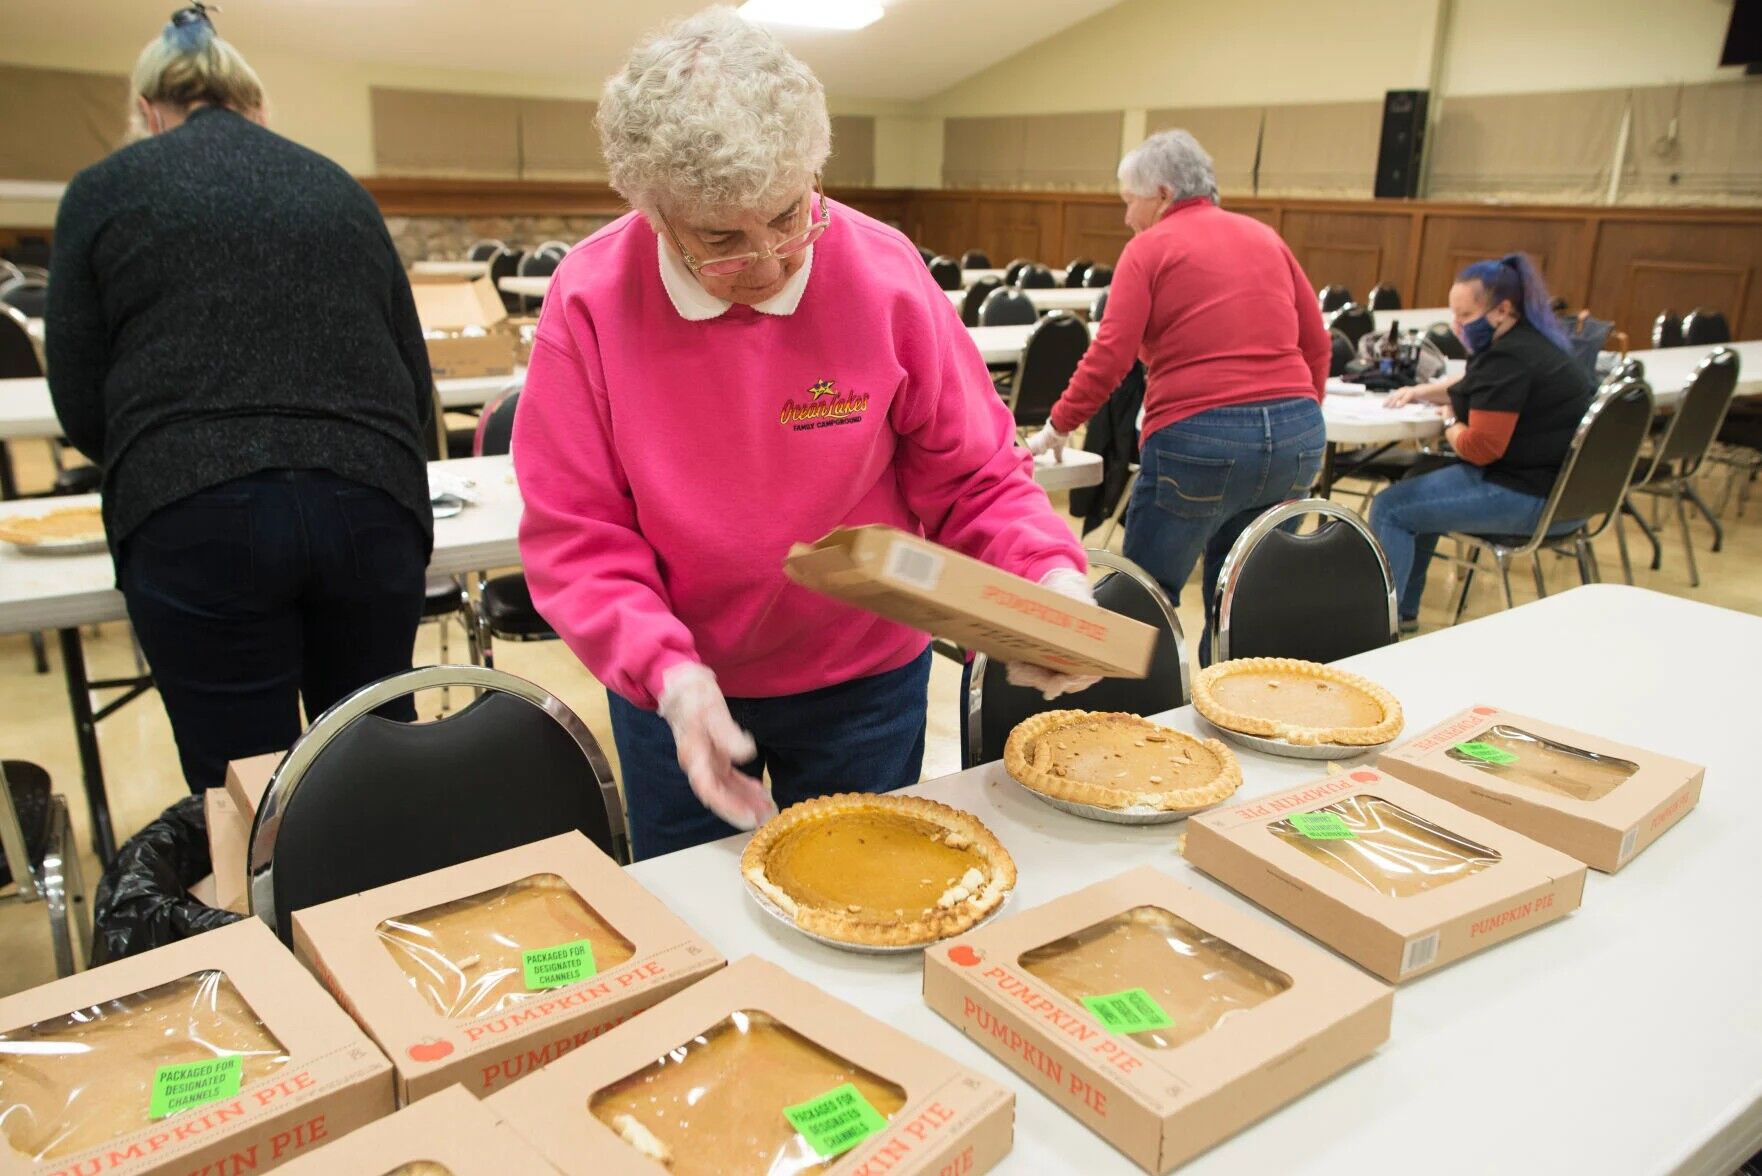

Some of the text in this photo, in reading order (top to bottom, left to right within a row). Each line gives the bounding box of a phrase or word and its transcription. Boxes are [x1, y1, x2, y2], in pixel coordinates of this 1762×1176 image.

[793, 416, 862, 431] FAMILY CAMPGROUND
[1471, 893, 1554, 937] PUMPKIN PIE
[527, 945, 586, 964] PACKAGED FOR
[534, 959, 582, 974] DESIGNATED
[539, 969, 581, 983] CHANNELS
[464, 981, 613, 1041] PUMPKIN
[615, 959, 666, 989] PIE
[982, 967, 1099, 1043] PUMPKIN
[1093, 1039, 1143, 1074] PIE
[160, 1060, 235, 1083] PACKAGED FOR
[963, 996, 1064, 1085] PUMPKIN
[1069, 1073, 1107, 1118] PIE
[165, 1073, 226, 1096] DESIGNATED
[168, 1087, 220, 1109] CHANNELS
[47, 1100, 246, 1176] UMPKIN
[254, 1071, 317, 1106] PIE
[269, 1113, 329, 1160] PIE
[904, 1102, 955, 1144] PIE
